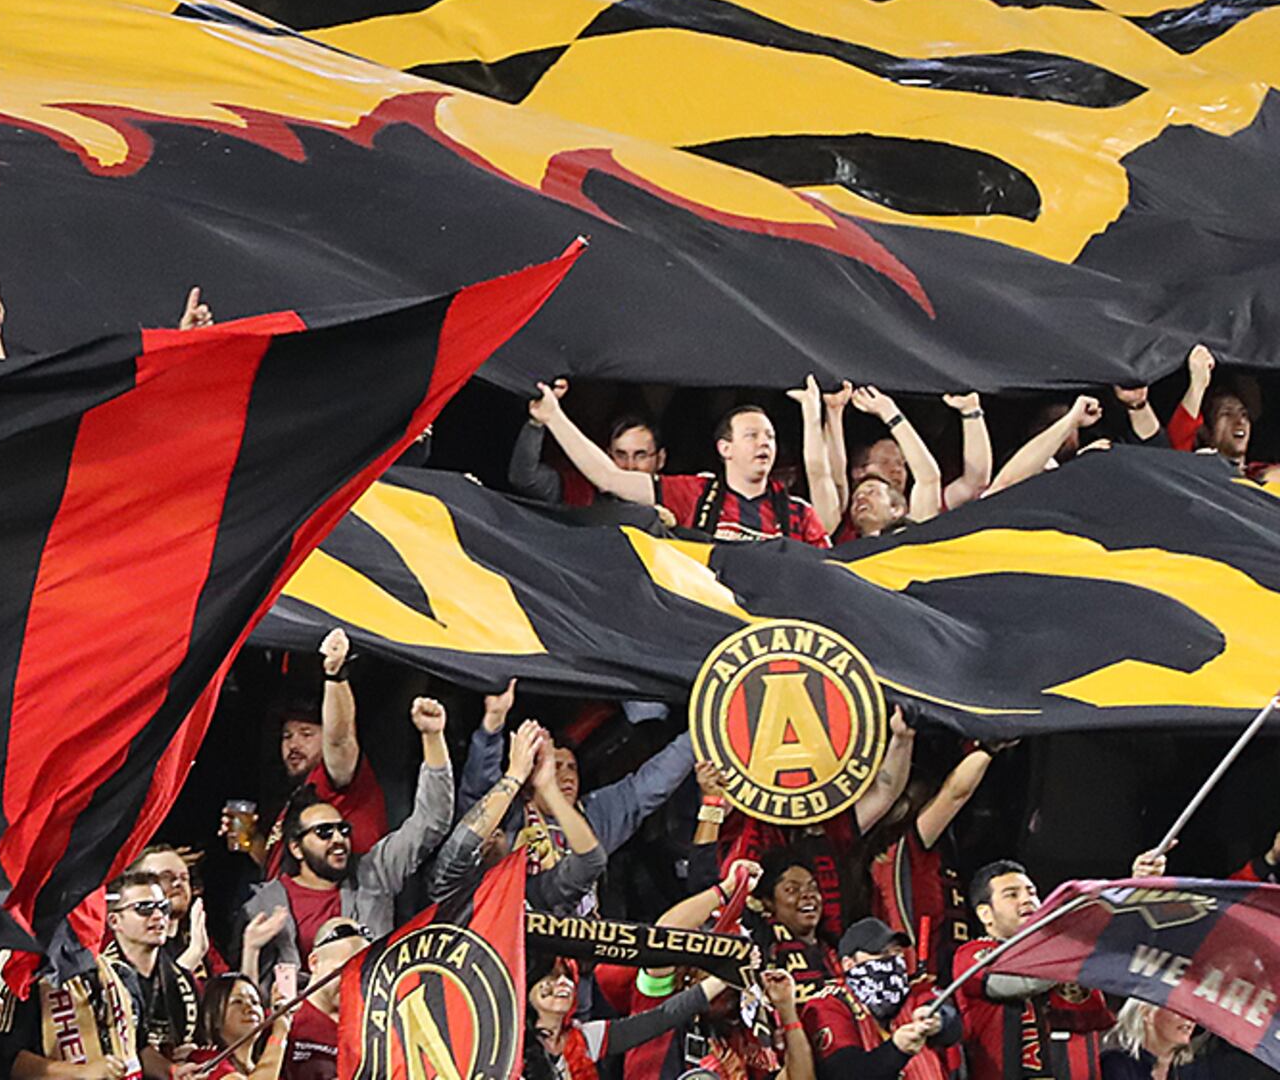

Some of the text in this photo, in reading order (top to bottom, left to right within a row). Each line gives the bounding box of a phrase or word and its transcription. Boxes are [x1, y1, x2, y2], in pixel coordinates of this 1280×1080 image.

[712, 627, 853, 684] ATLANTA
[748, 672, 842, 789] A
[832, 758, 871, 798] FC
[526, 913, 752, 960] RMINUS LEGION
[594, 944, 639, 959] 2017
[370, 933, 471, 1033] ATLANTA
[1128, 943, 1277, 1028] WE ARE
